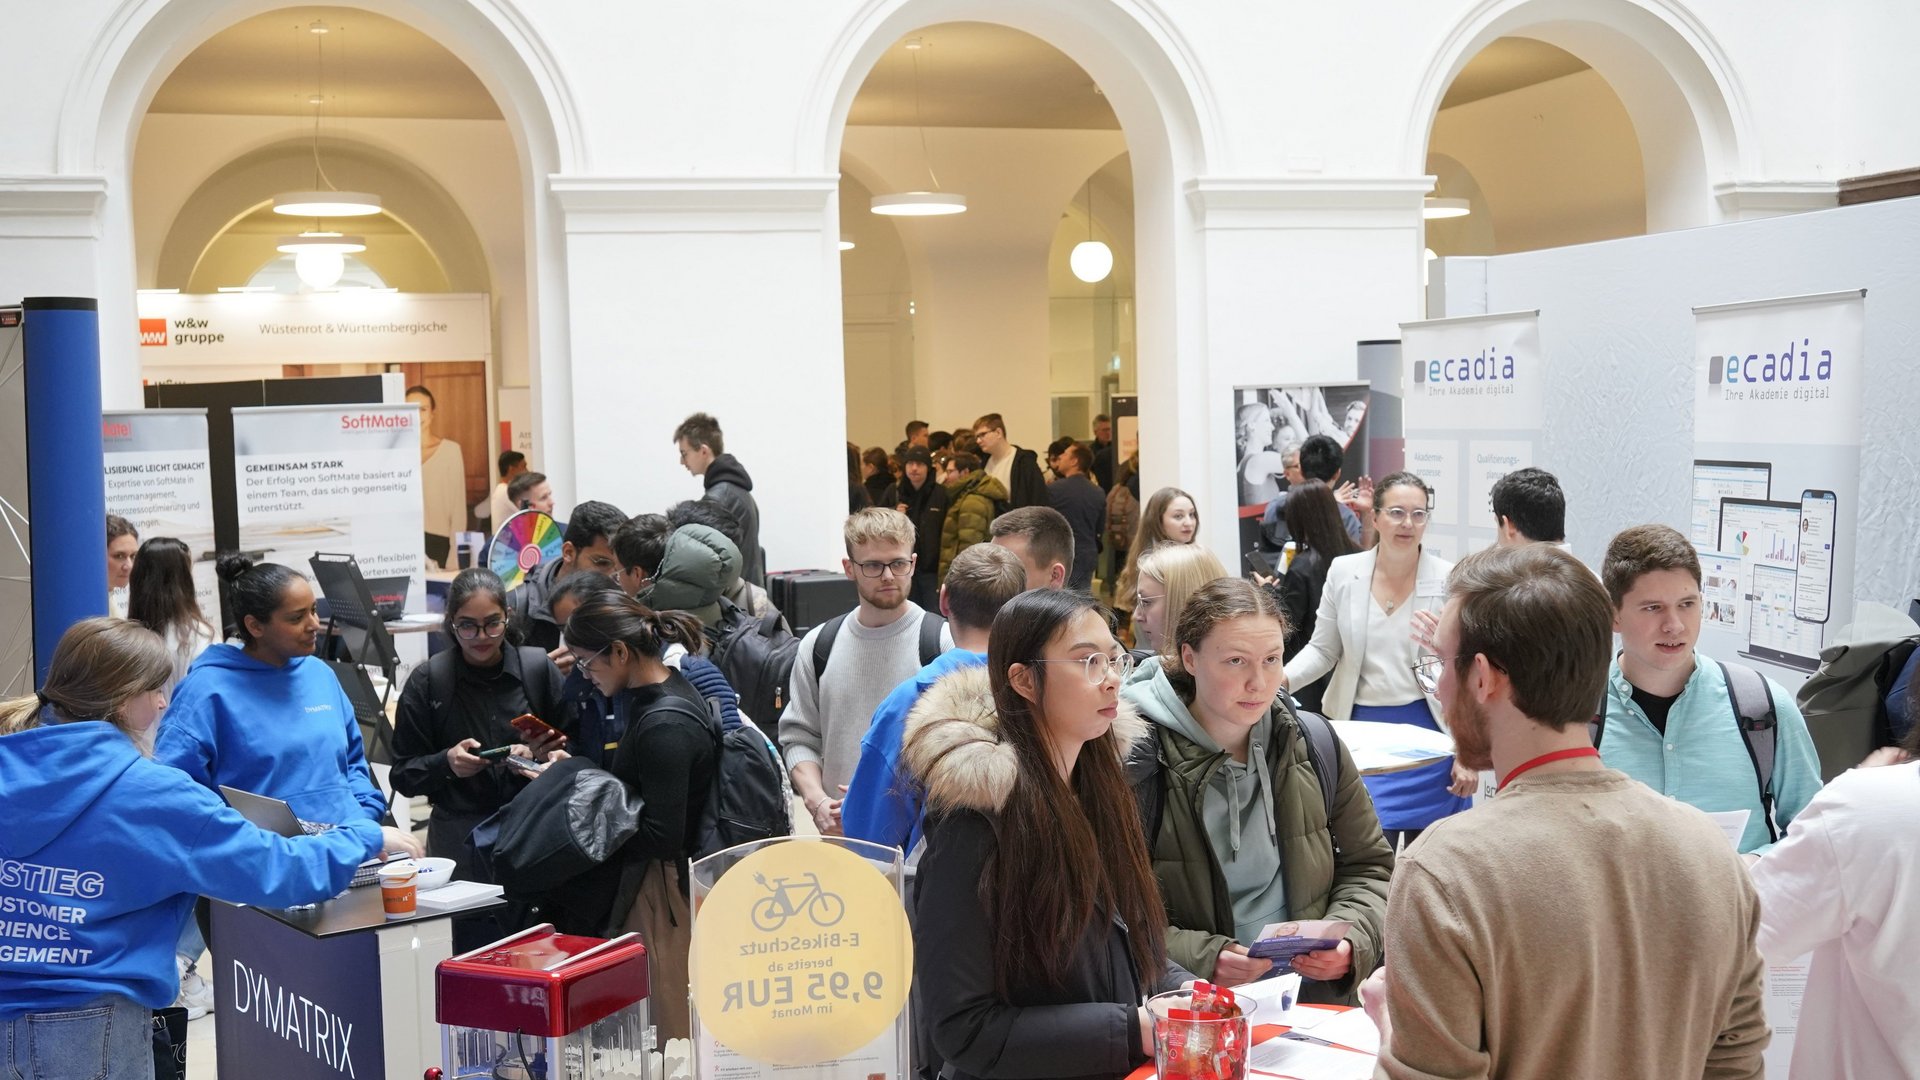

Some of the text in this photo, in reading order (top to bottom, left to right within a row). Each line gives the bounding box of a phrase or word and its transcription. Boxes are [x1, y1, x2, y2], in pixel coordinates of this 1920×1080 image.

[174, 318, 209, 329] w&w
[258, 321, 448, 335] Wüstenrot & Württembergische
[174, 333, 225, 345] gruppe
[1428, 346, 1514, 382] ecadia
[1726, 338, 1832, 383] ecadia
[1428, 384, 1515, 396] Ihre Akademie digital
[1725, 386, 1830, 402] Ihre Akademie digital
[145, 463, 171, 473] LEICHT
[172, 462, 205, 472] GEMACHT
[246, 460, 344, 474] GEMEINSAM STARK
[143, 479, 155, 487] von
[246, 469, 413, 487] Der Erfolg von SoftMate basiert auf
[246, 481, 408, 501] einem Team, das sich gegenseitig
[187, 502, 200, 511] und
[247, 502, 305, 514] unterstützt.
[377, 552, 417, 563] flexiblen
[391, 565, 417, 576] sowie
[0, 858, 105, 899] STIEG
[0, 896, 87, 924] STOMER
[233, 959, 355, 1080] DYMATRIX
